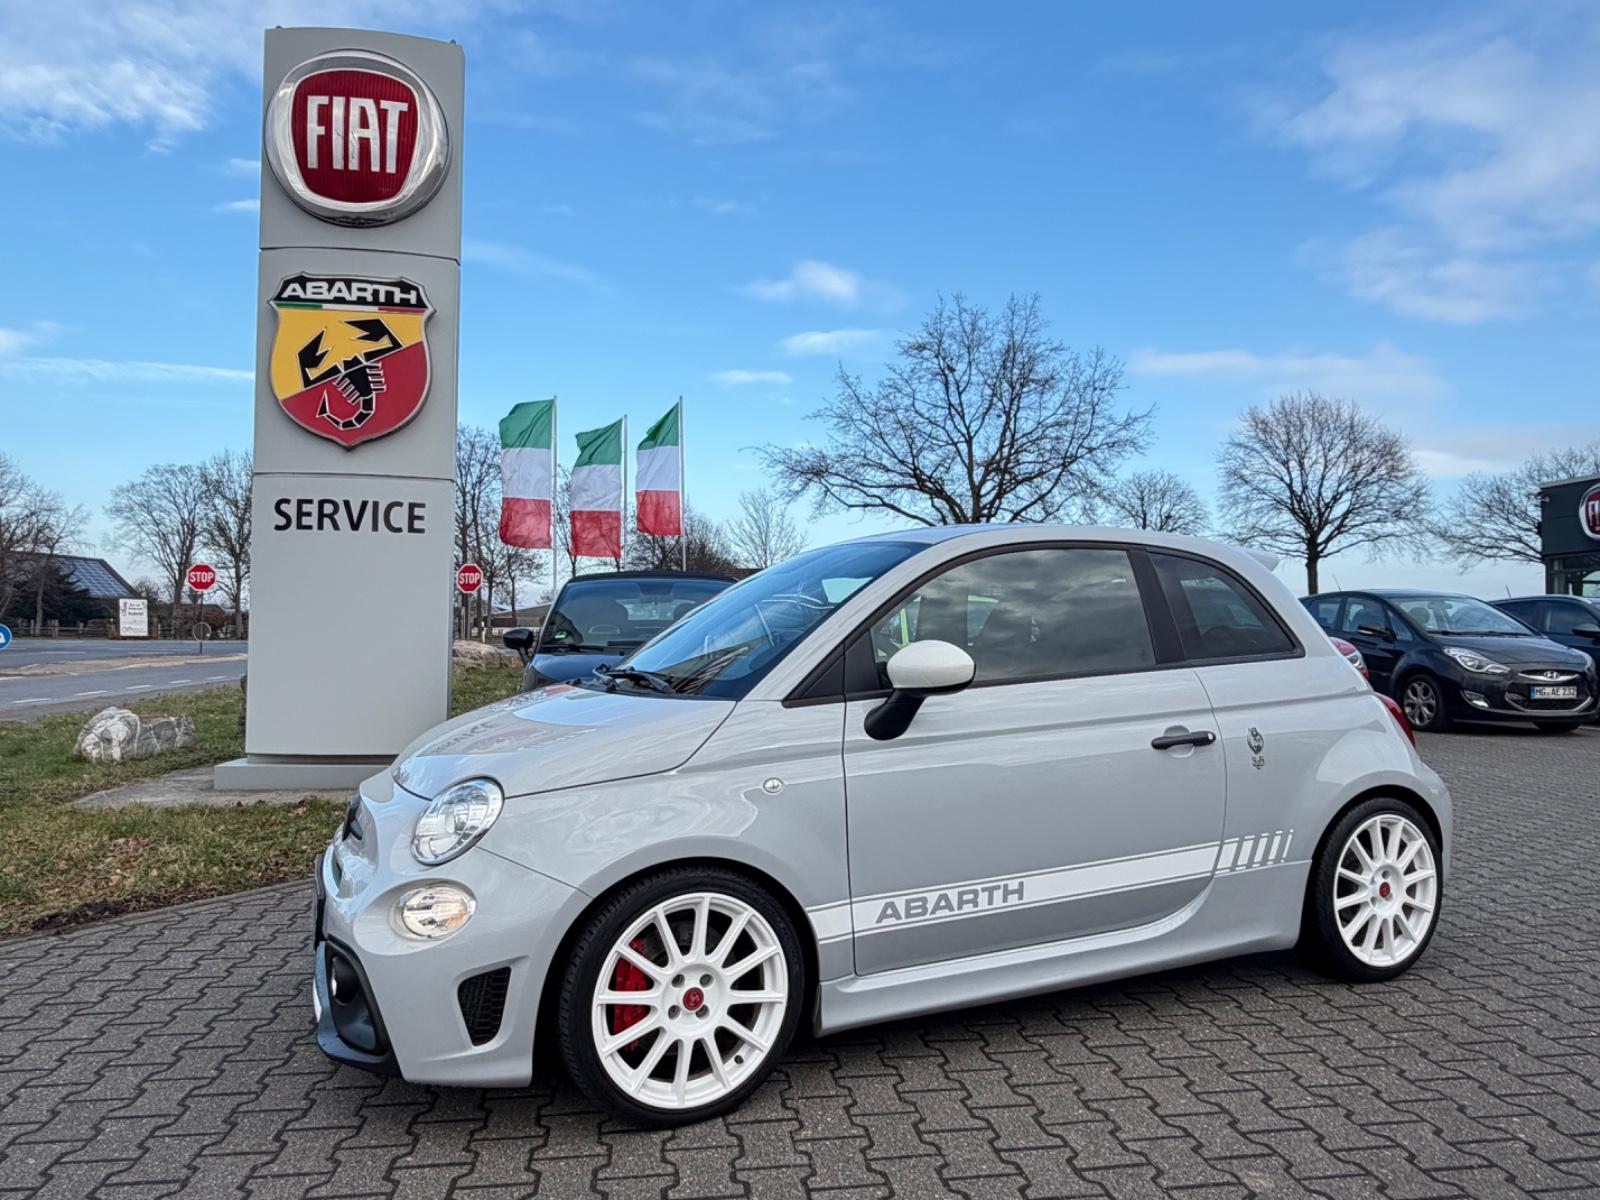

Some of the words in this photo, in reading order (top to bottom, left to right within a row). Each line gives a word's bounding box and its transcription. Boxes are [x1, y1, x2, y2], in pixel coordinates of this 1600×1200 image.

[306, 95, 409, 174] FIAT
[281, 281, 418, 304] ABARTH
[273, 498, 426, 534] SERVICE
[1587, 499, 1600, 527] FI
[189, 571, 214, 583] STOP
[459, 572, 480, 584] STOP
[875, 881, 1024, 924] ABARTH
